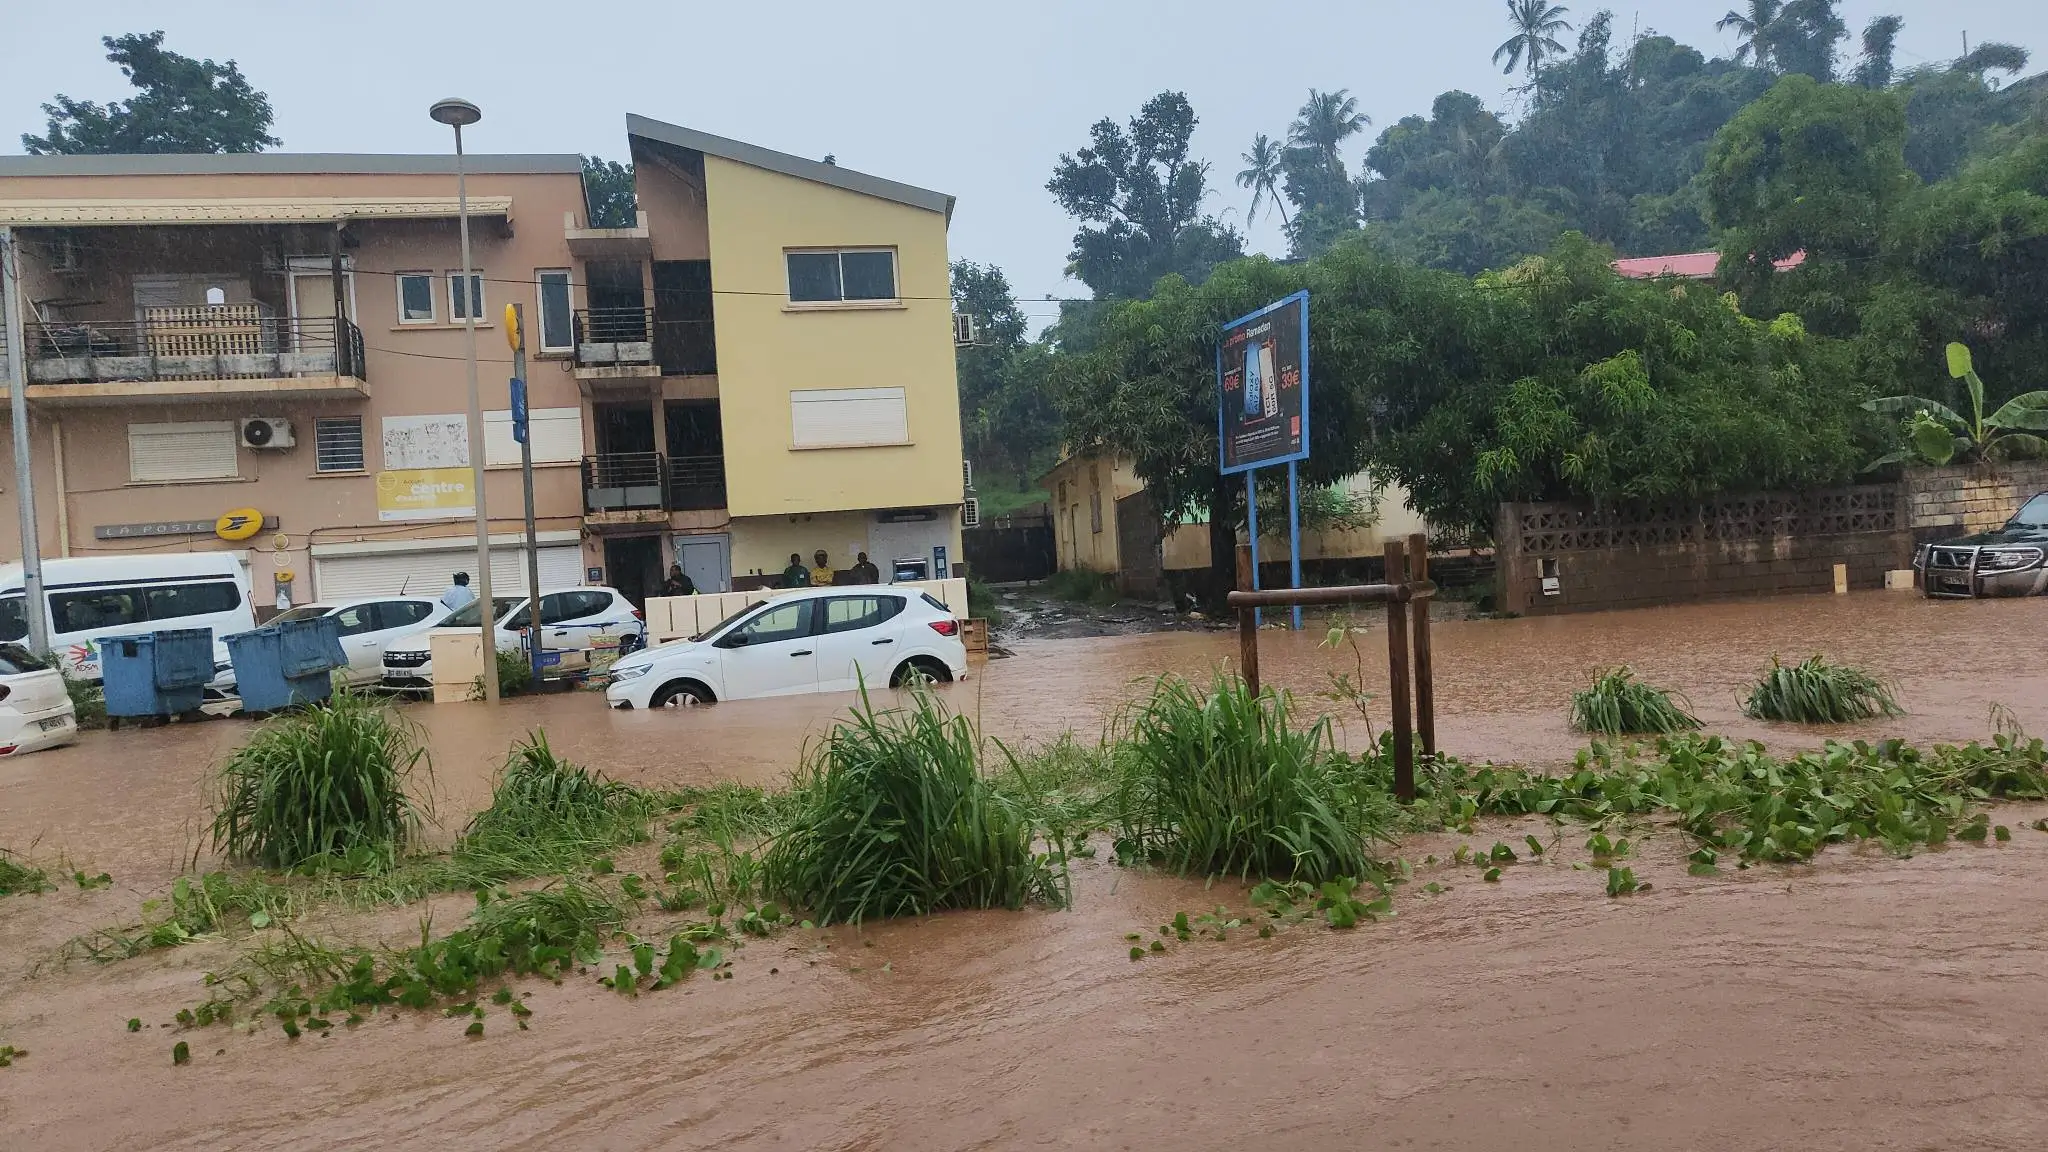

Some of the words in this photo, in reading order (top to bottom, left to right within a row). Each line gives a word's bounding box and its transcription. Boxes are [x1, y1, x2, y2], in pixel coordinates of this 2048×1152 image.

[1246, 321, 1271, 339] Ramadan
[1224, 373, 1240, 392] 69€
[1281, 370, 1299, 389] 39€
[412, 481, 465, 494] centre
[106, 526, 130, 536] LA
[143, 523, 205, 535] POSTE
[75, 663, 99, 672] ADSM
